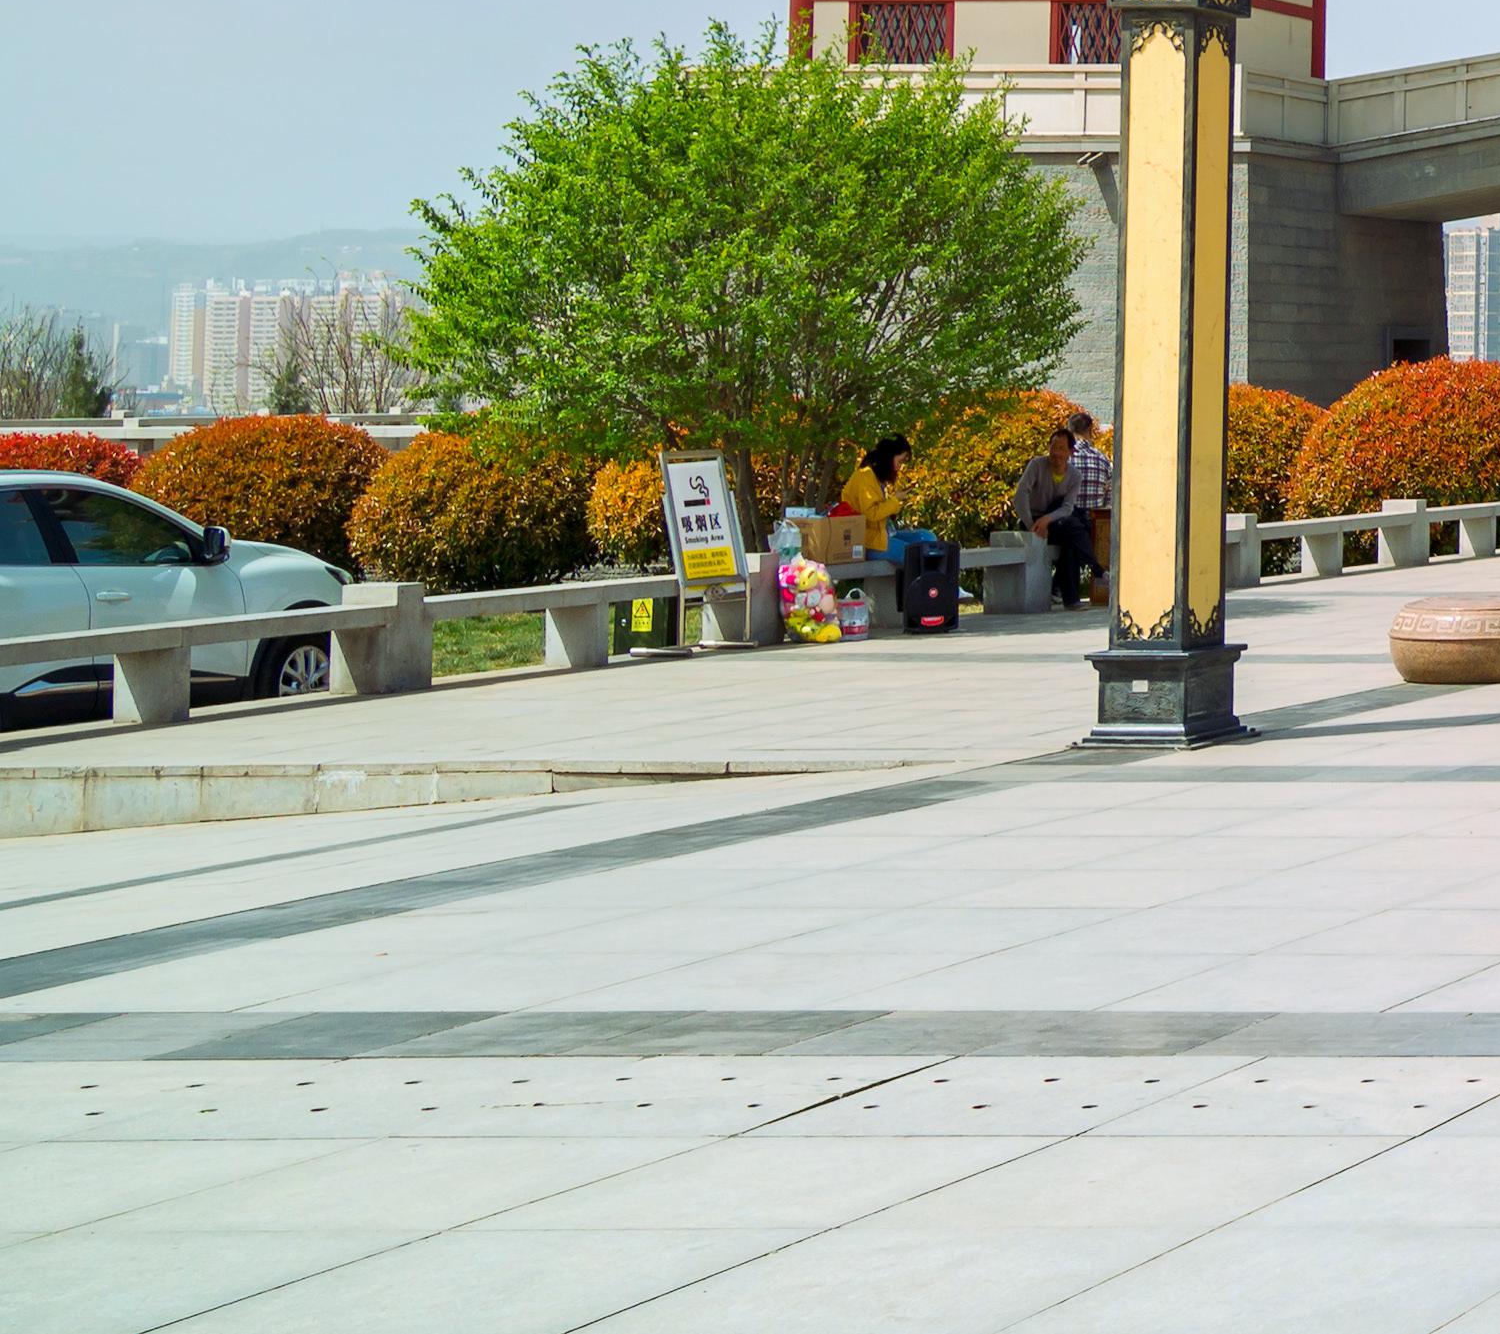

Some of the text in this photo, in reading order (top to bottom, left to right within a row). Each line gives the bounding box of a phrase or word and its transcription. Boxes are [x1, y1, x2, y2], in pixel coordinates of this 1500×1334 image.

[681, 513, 722, 533] 吸烟区
[684, 534, 725, 544] Smoking Area
